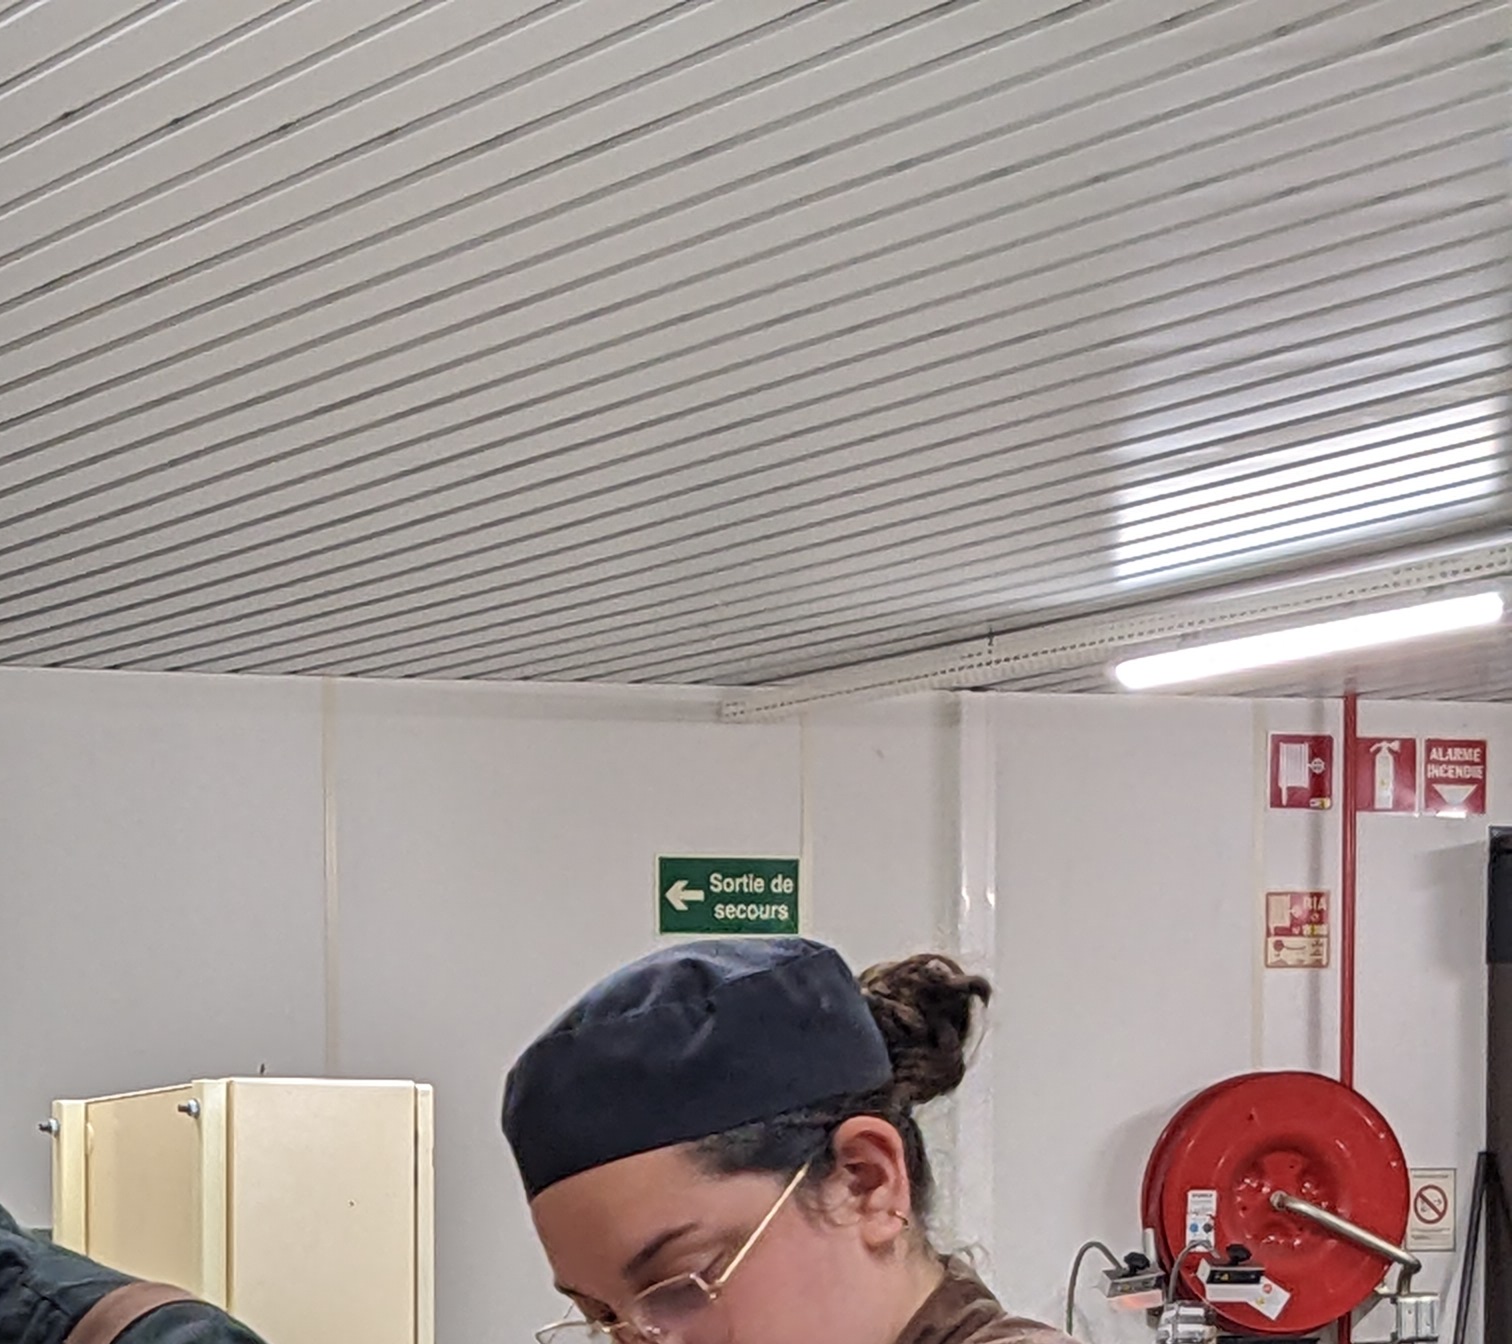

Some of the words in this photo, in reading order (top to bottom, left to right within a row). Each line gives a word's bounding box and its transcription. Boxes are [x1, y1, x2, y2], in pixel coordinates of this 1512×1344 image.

[1430, 747, 1481, 762] ALARME
[1427, 764, 1483, 779] INCENDIE
[710, 873, 764, 893] Sortie
[770, 873, 794, 894] de
[714, 903, 789, 921] secours
